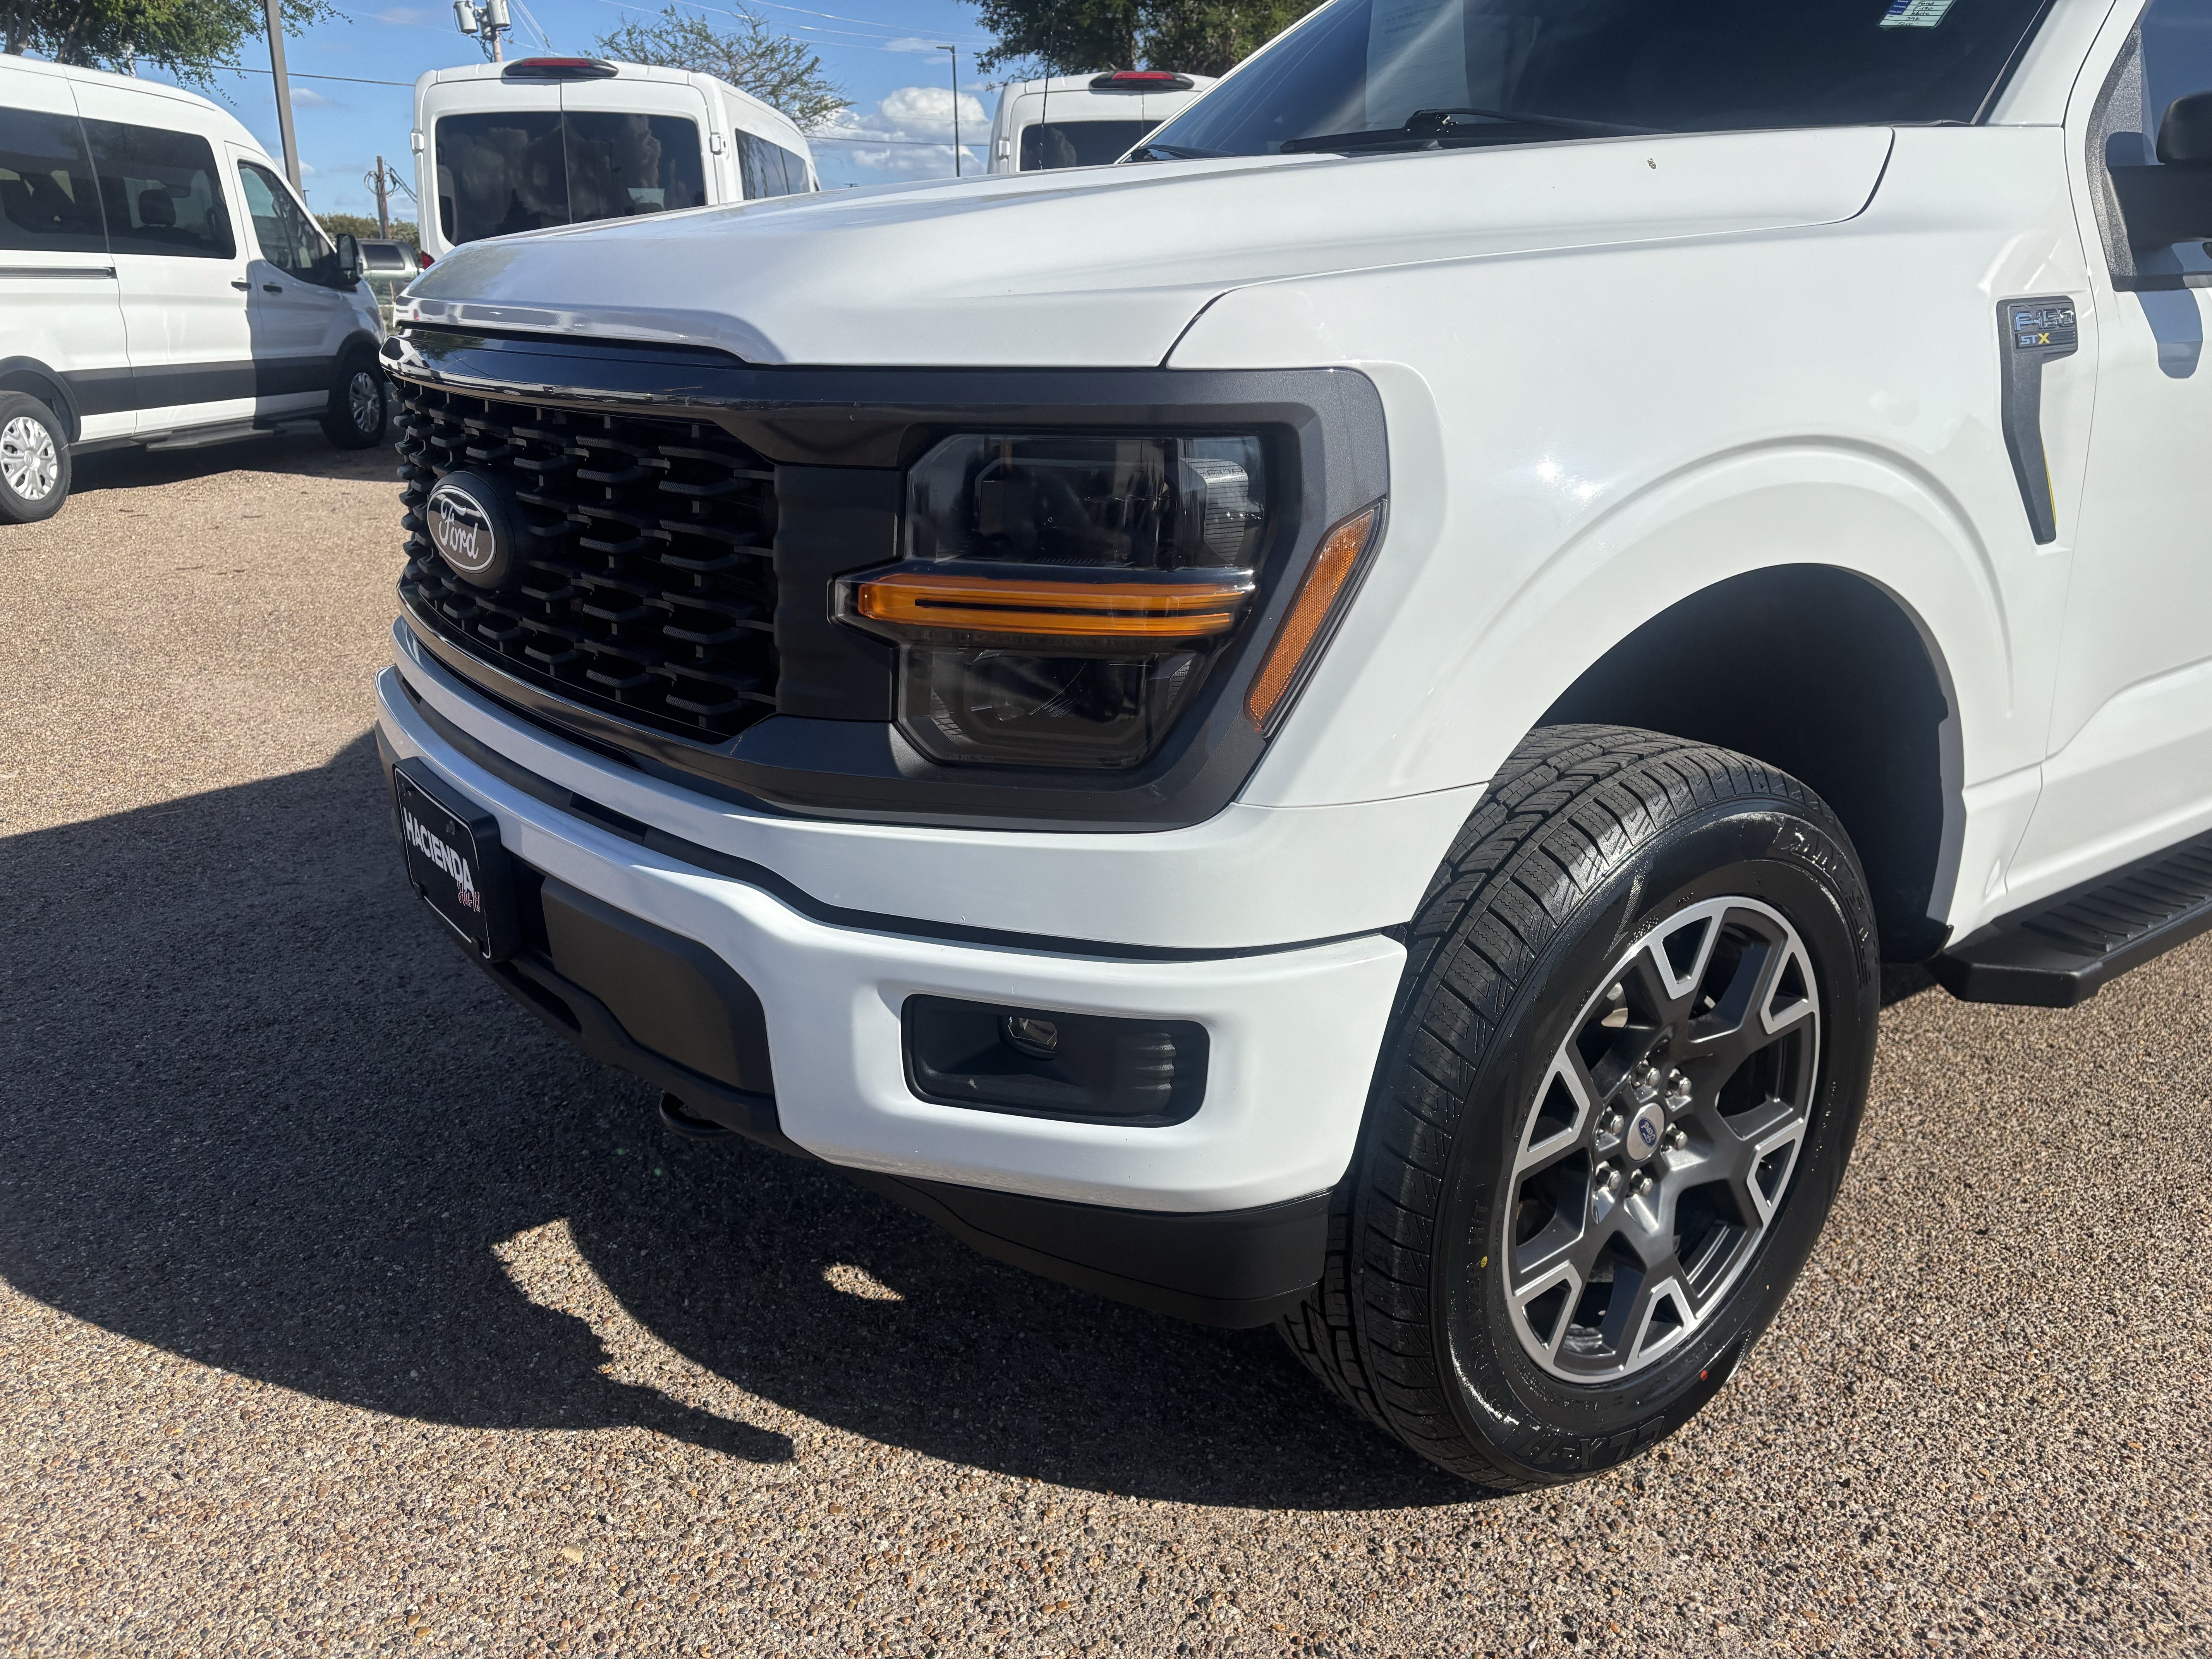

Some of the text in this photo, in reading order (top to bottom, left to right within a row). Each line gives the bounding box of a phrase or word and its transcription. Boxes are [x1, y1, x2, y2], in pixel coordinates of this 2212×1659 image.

[2020, 332, 2051, 345] STX
[439, 497, 479, 559] Ford
[403, 807, 476, 896] HACIENDA
[1641, 1121, 1656, 1144] Ford
